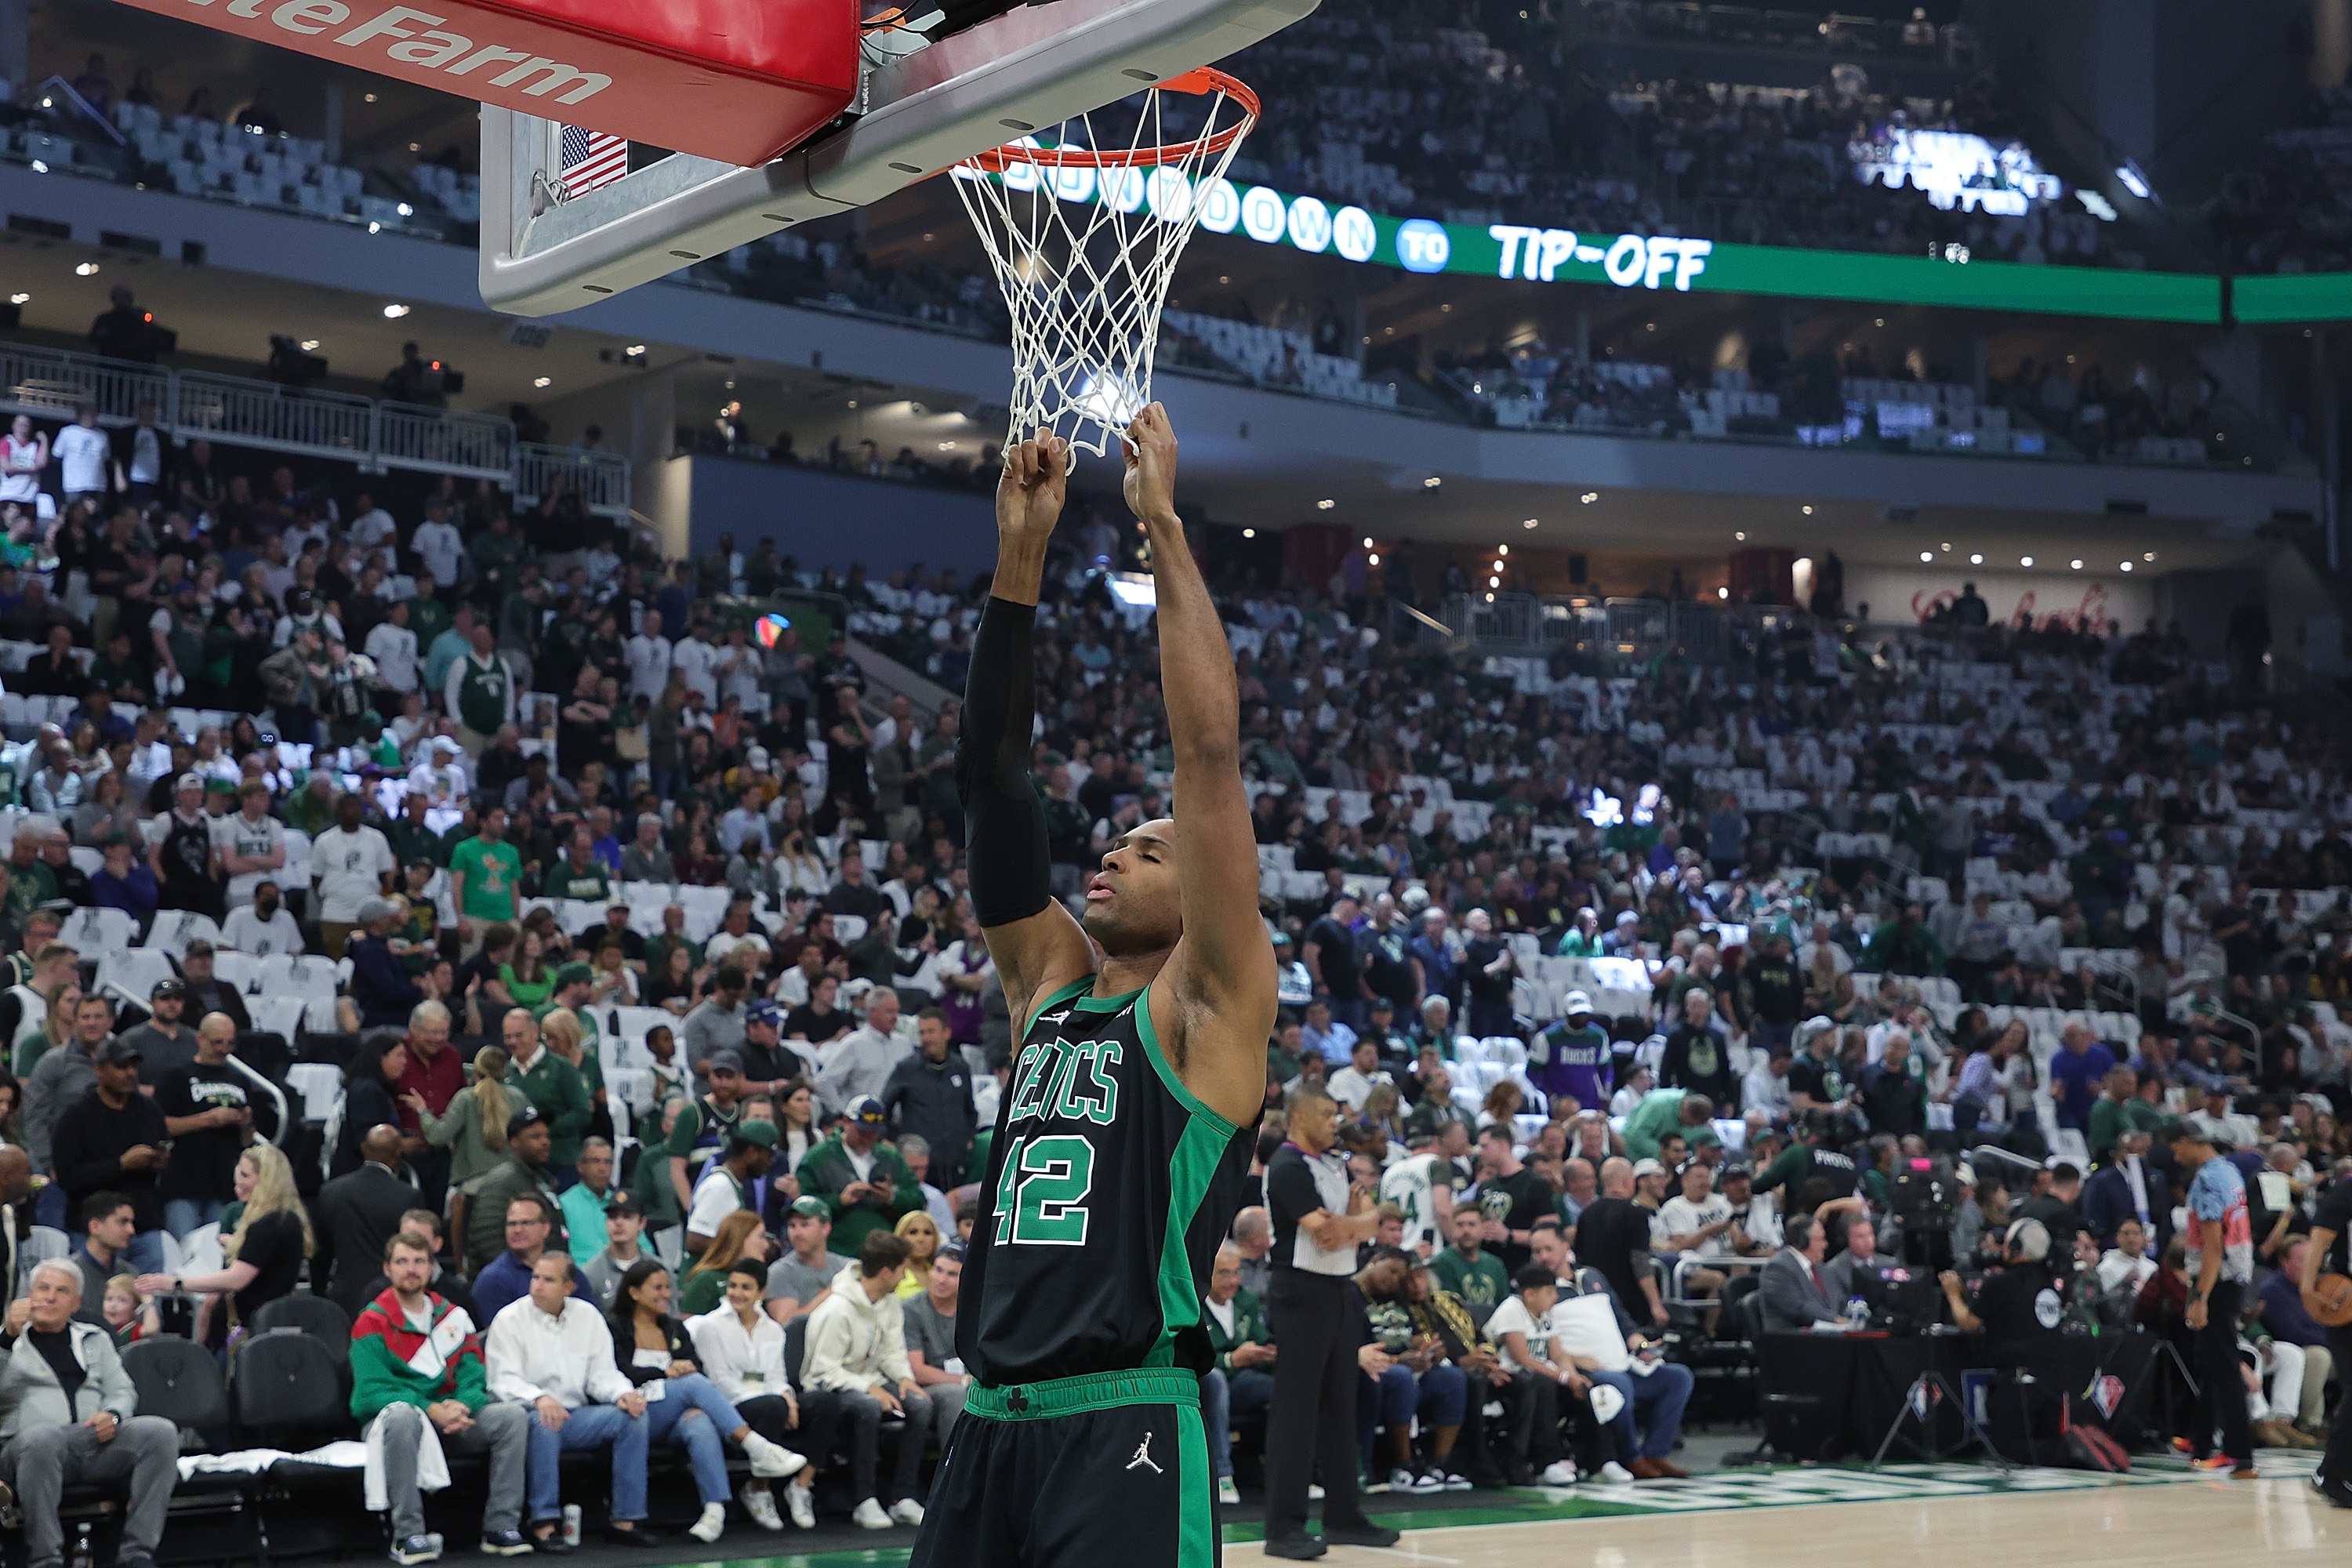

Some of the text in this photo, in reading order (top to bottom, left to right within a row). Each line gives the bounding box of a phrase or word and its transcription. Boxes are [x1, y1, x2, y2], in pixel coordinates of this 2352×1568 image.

[1403, 230, 1445, 263] TO
[1489, 224, 1712, 292] TIP-OFF
[1560, 1046, 1596, 1065] BUCKS
[1813, 1149, 1855, 1171] PHOTO
[992, 1134, 1095, 1247] 42
